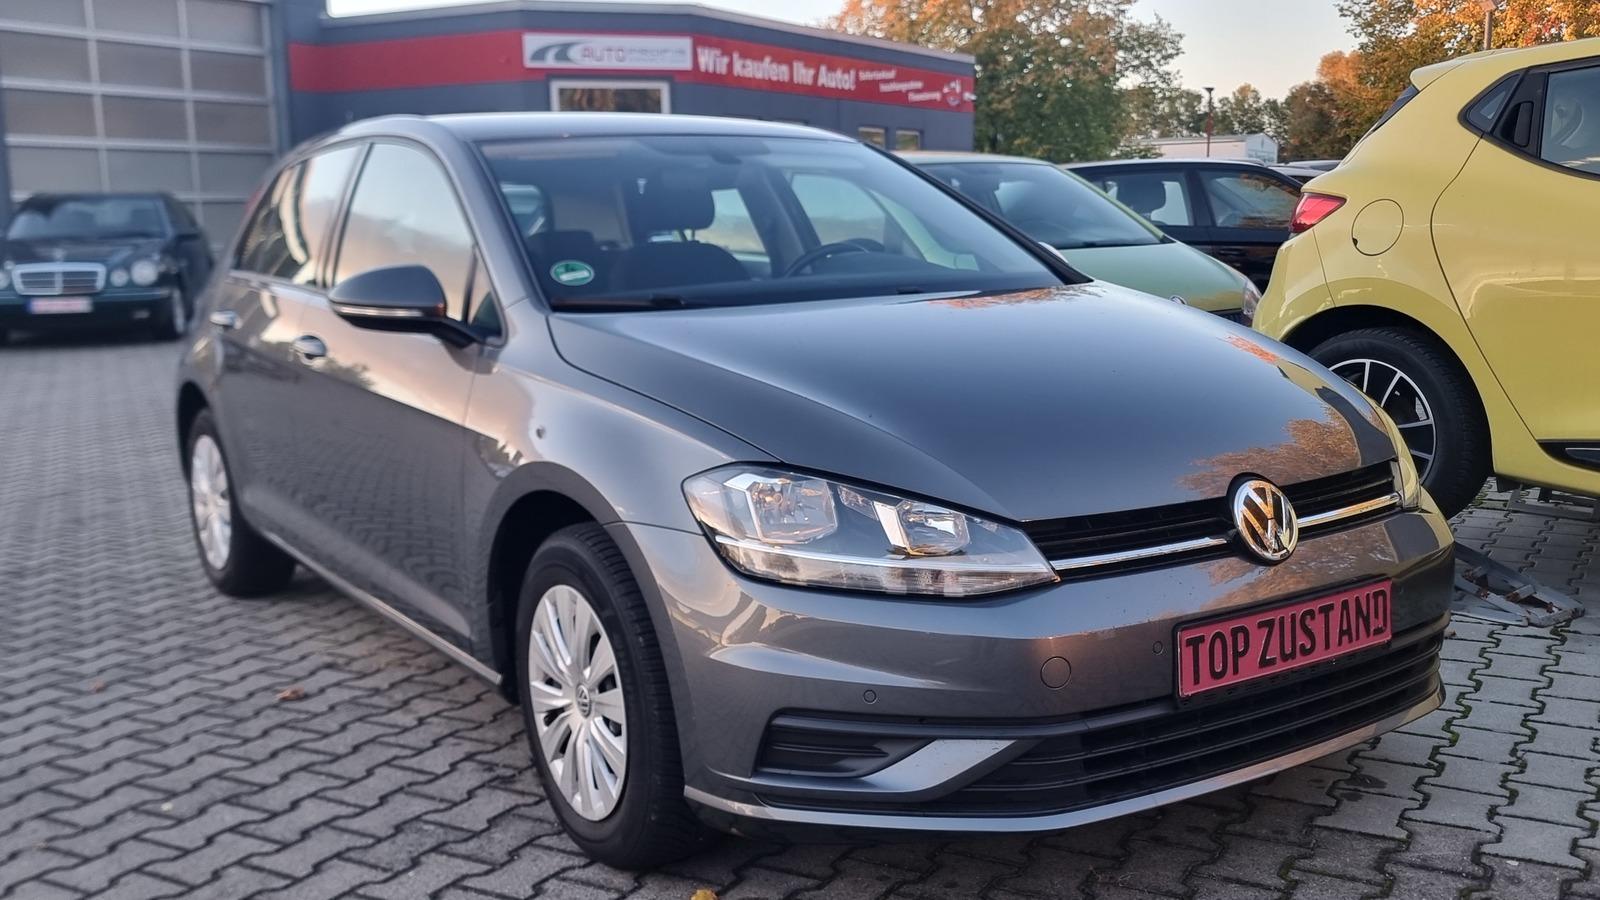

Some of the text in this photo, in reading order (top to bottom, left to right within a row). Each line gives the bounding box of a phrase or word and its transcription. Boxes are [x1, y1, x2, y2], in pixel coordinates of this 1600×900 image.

[697, 46, 730, 75] Wir
[732, 51, 790, 83] kaufen
[792, 60, 817, 86] Ihr
[817, 64, 857, 91] Auto!
[1185, 589, 1388, 686] TOP ZUSTAND
